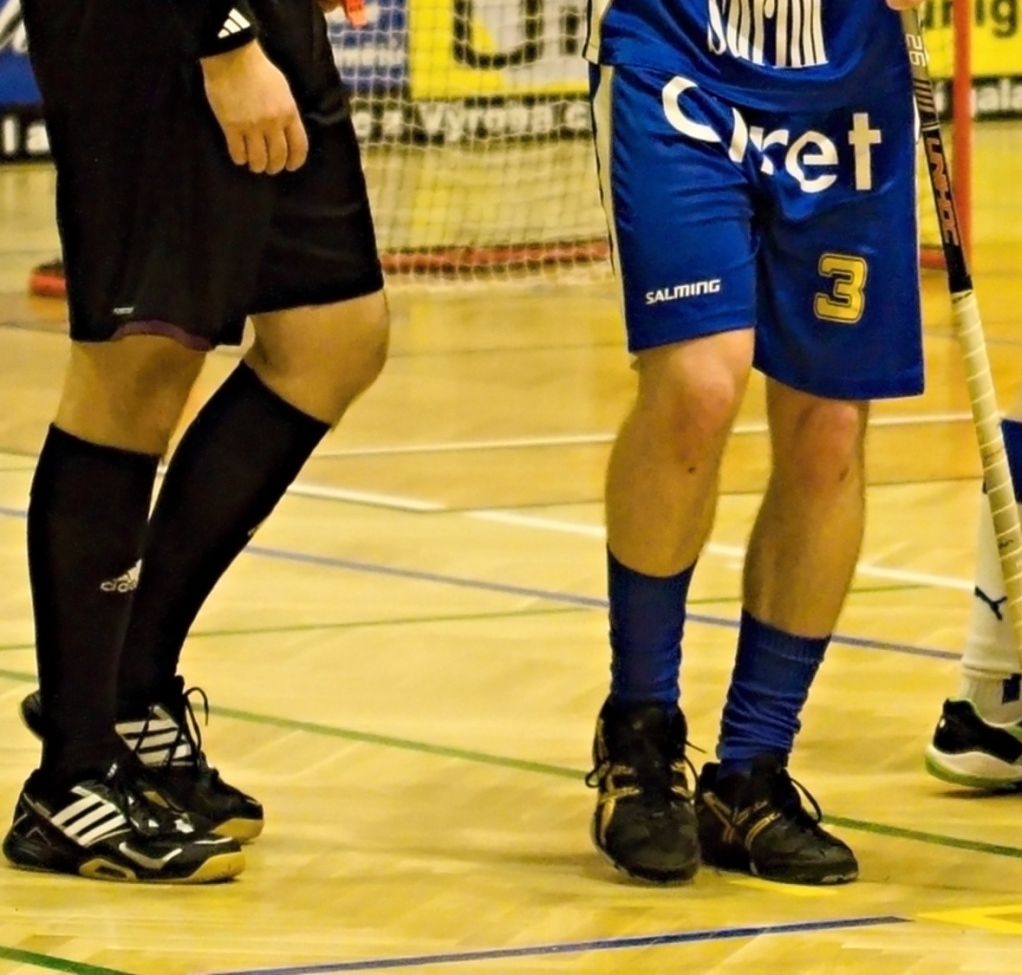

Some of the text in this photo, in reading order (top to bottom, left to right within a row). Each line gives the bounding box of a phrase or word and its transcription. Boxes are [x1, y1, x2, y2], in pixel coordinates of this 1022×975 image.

[905, 33, 927, 67] 26
[645, 279, 721, 305] SALMING
[814, 253, 868, 324] 3
